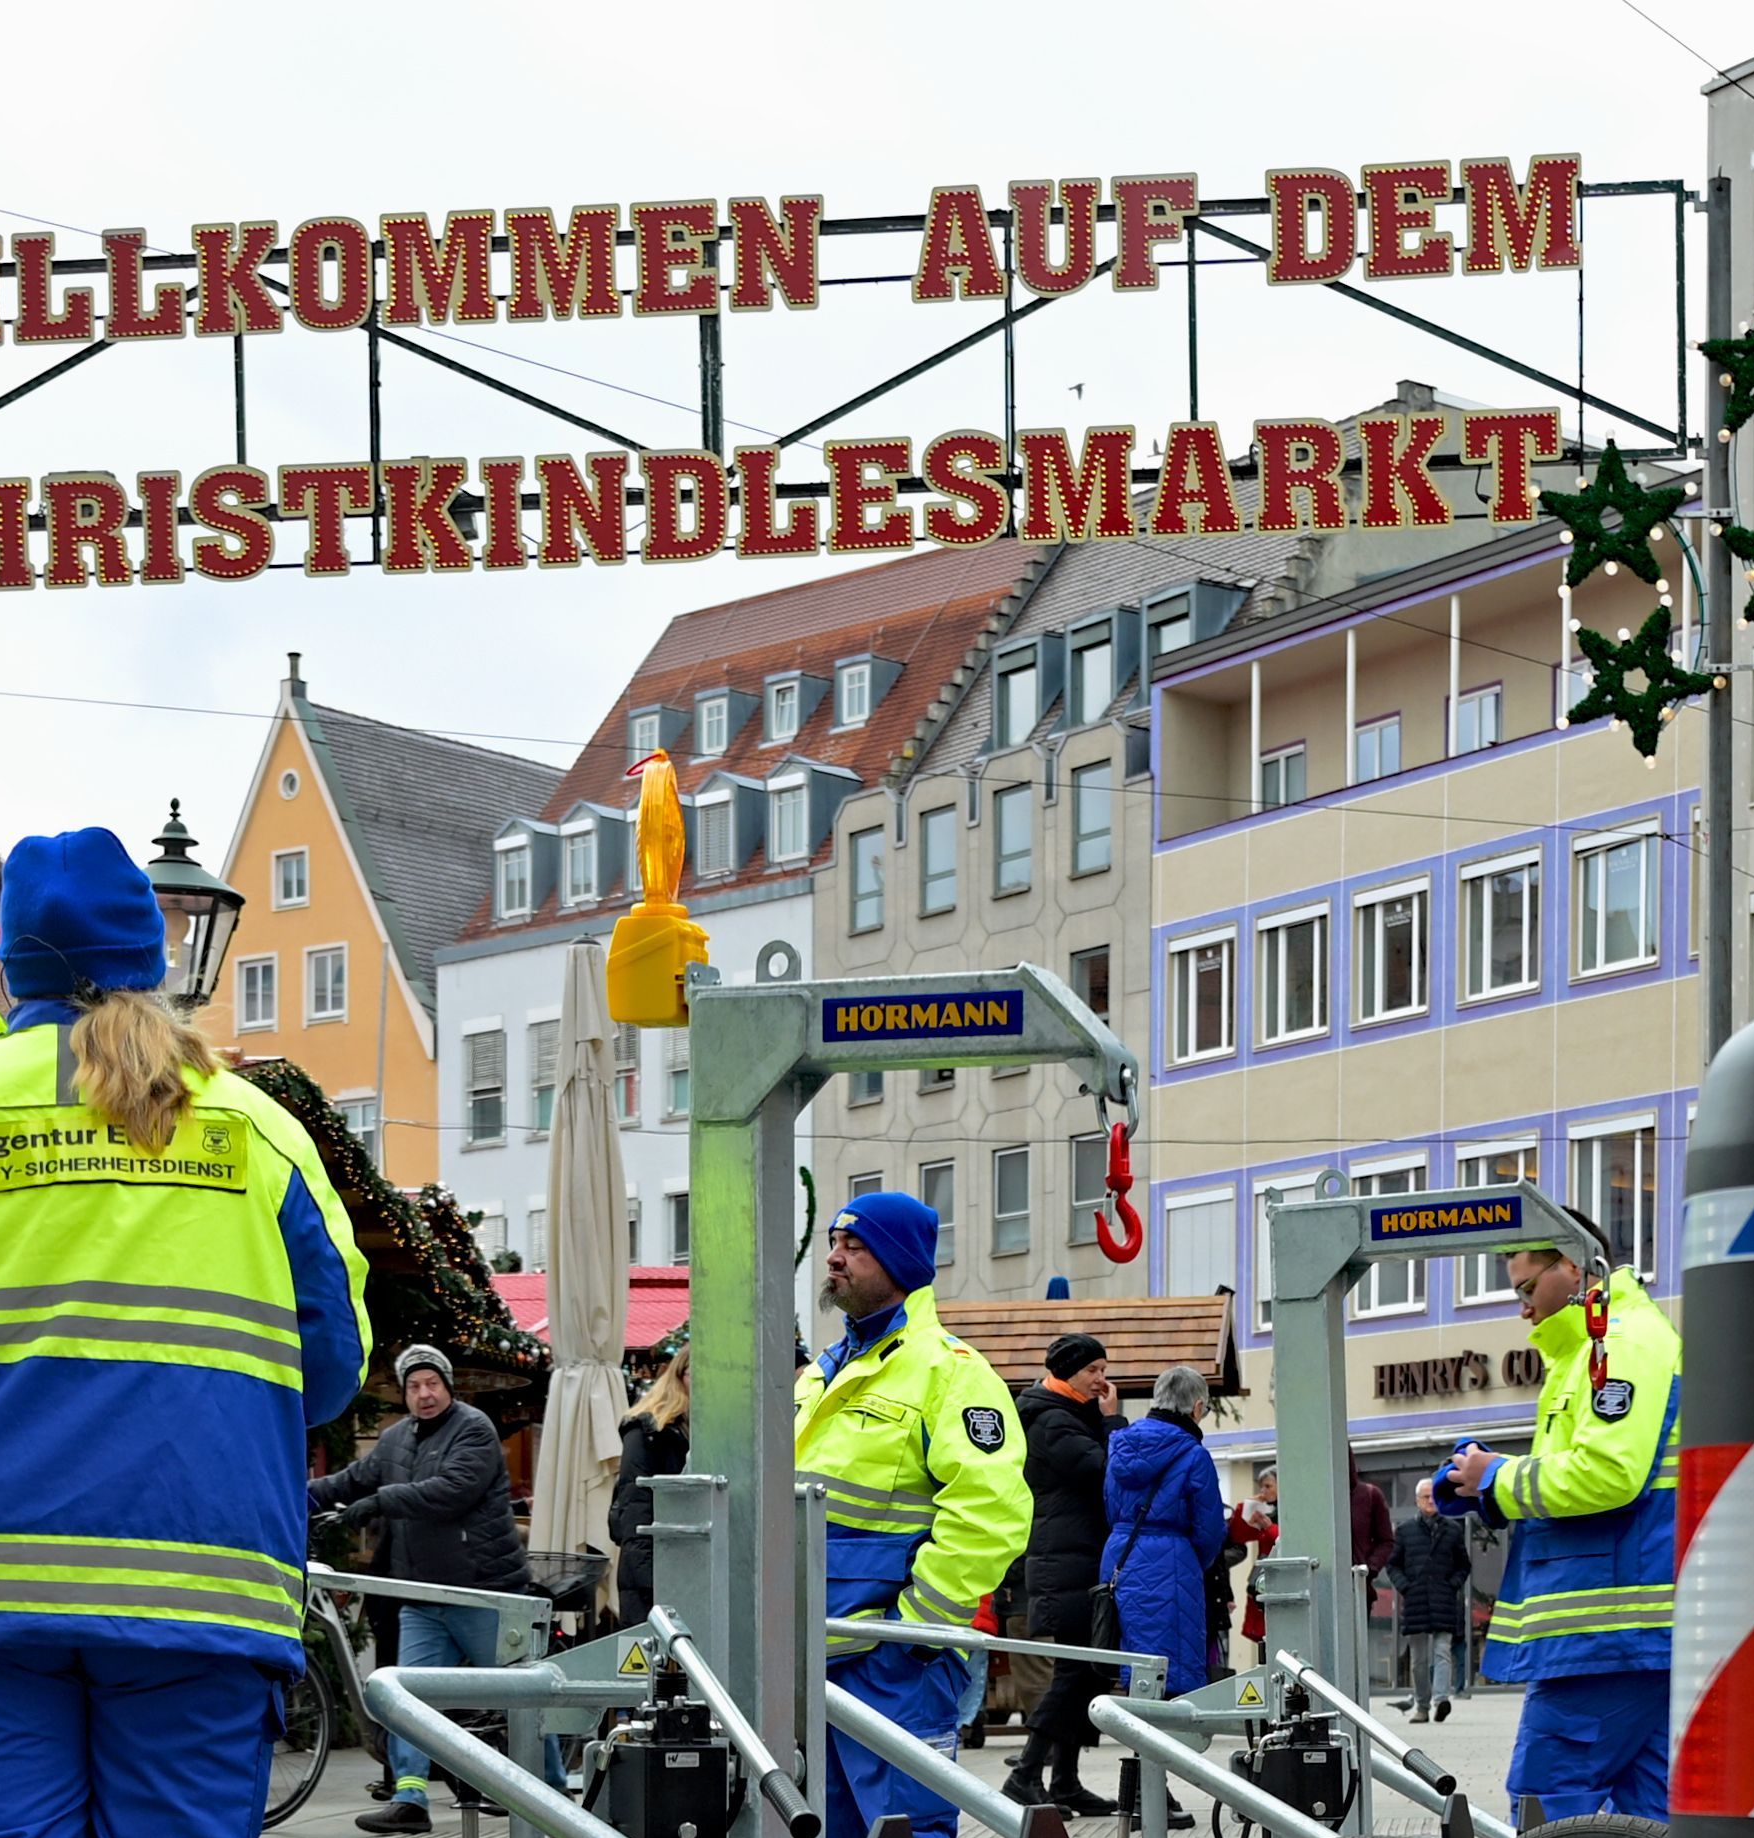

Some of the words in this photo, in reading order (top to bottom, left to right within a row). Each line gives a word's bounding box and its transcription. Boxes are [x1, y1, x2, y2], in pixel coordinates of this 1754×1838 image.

[912, 171, 1200, 303] AUF
[1264, 152, 1583, 287] DEM
[1373, 1350, 1489, 1399] HENRY'S
[1502, 1348, 1545, 1386] CO
